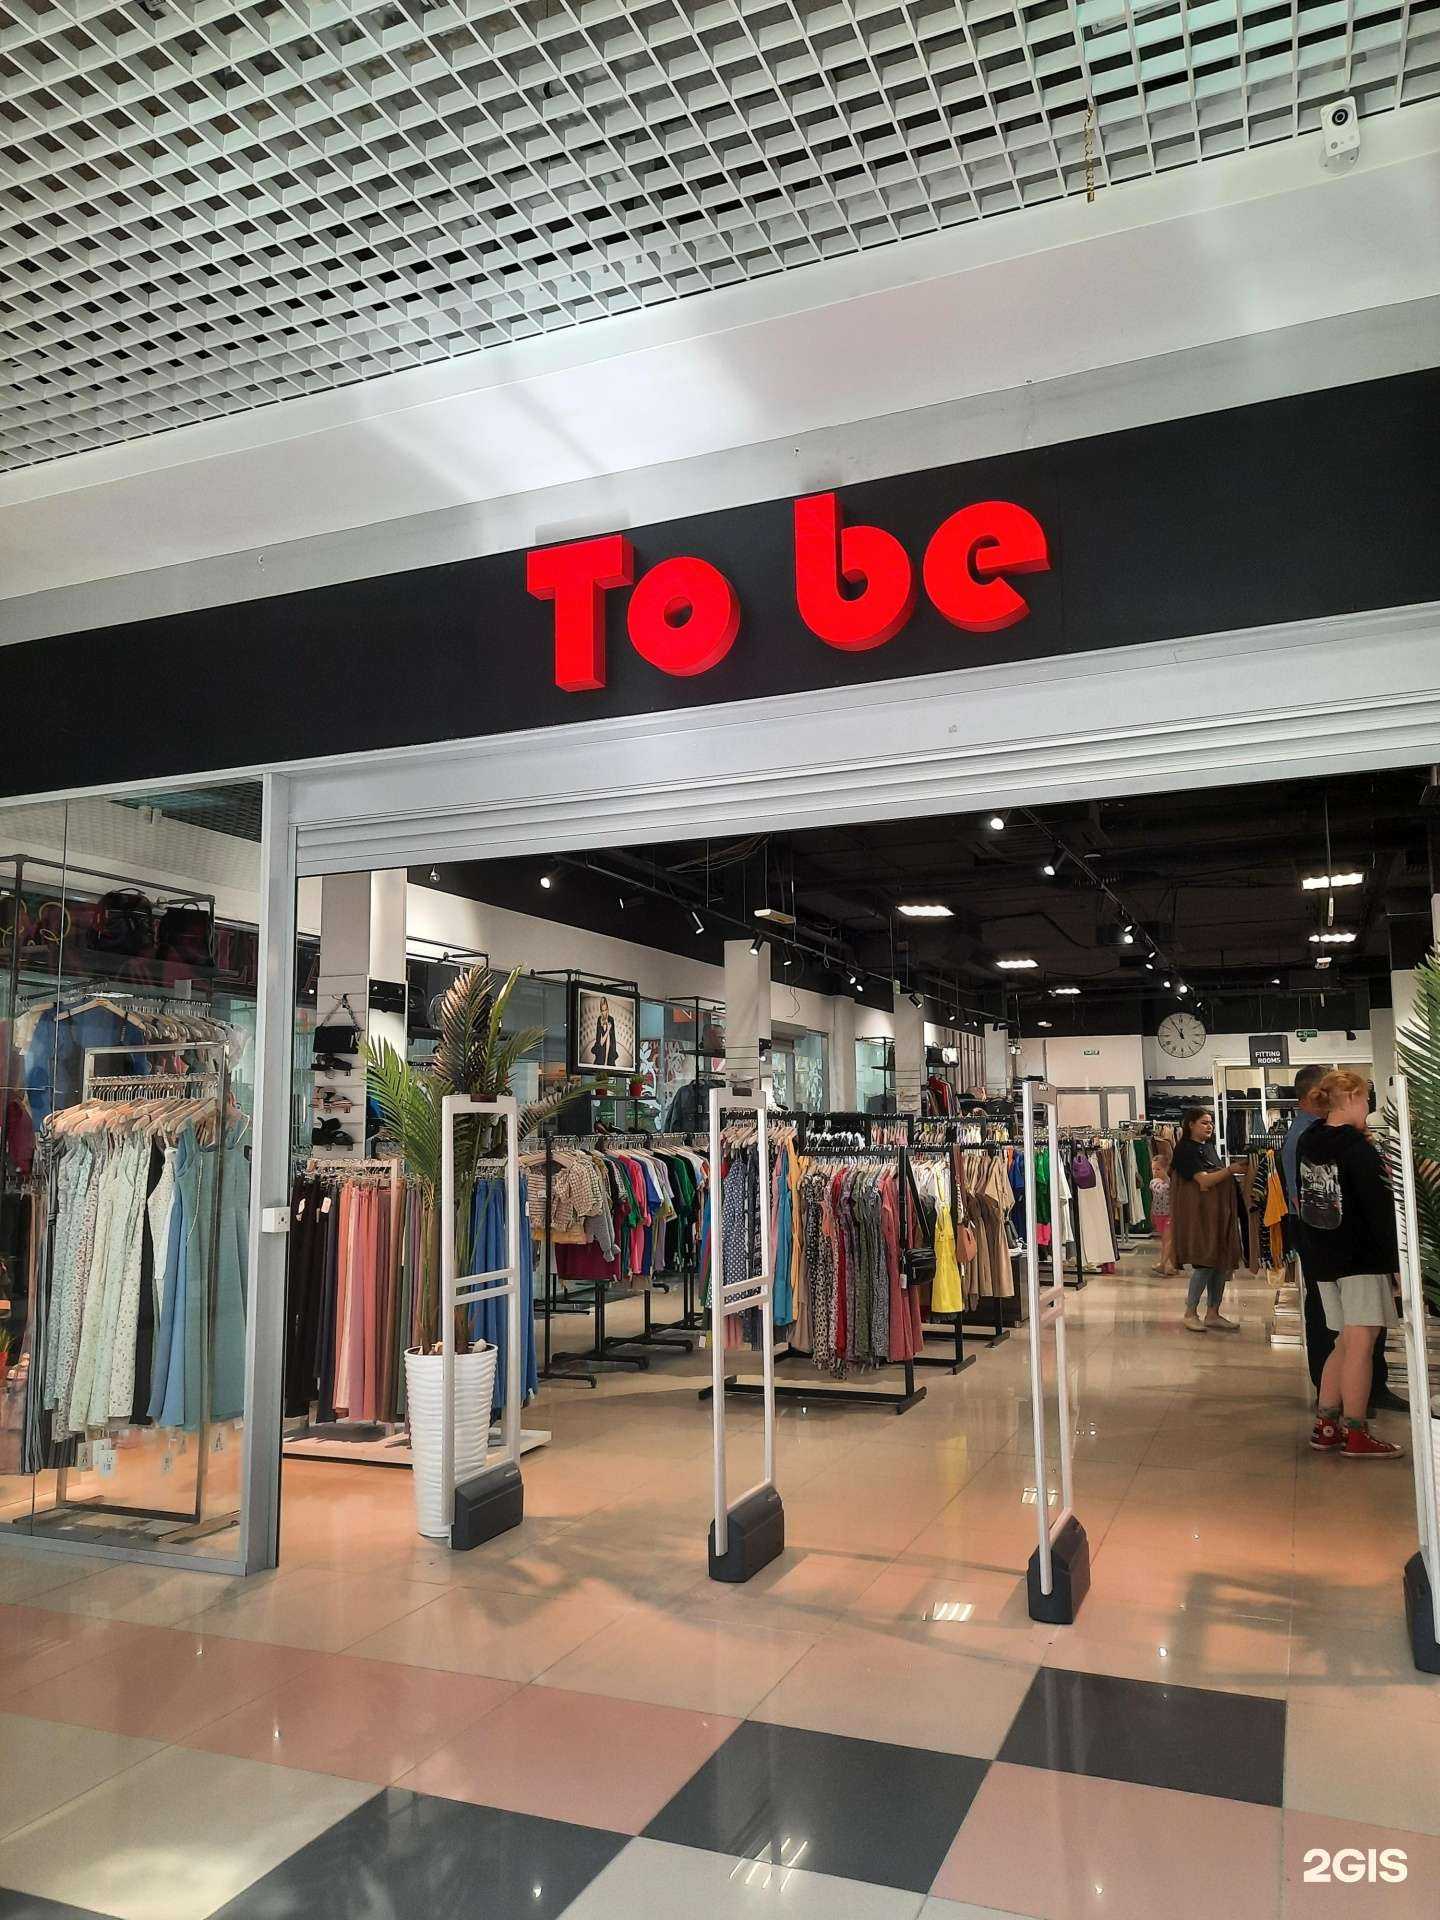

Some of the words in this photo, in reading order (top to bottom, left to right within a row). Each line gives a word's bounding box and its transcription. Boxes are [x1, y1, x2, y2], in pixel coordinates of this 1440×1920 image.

[526, 534, 741, 693] To
[793, 491, 1052, 652] be
[1255, 1050, 1281, 1058] FITTING
